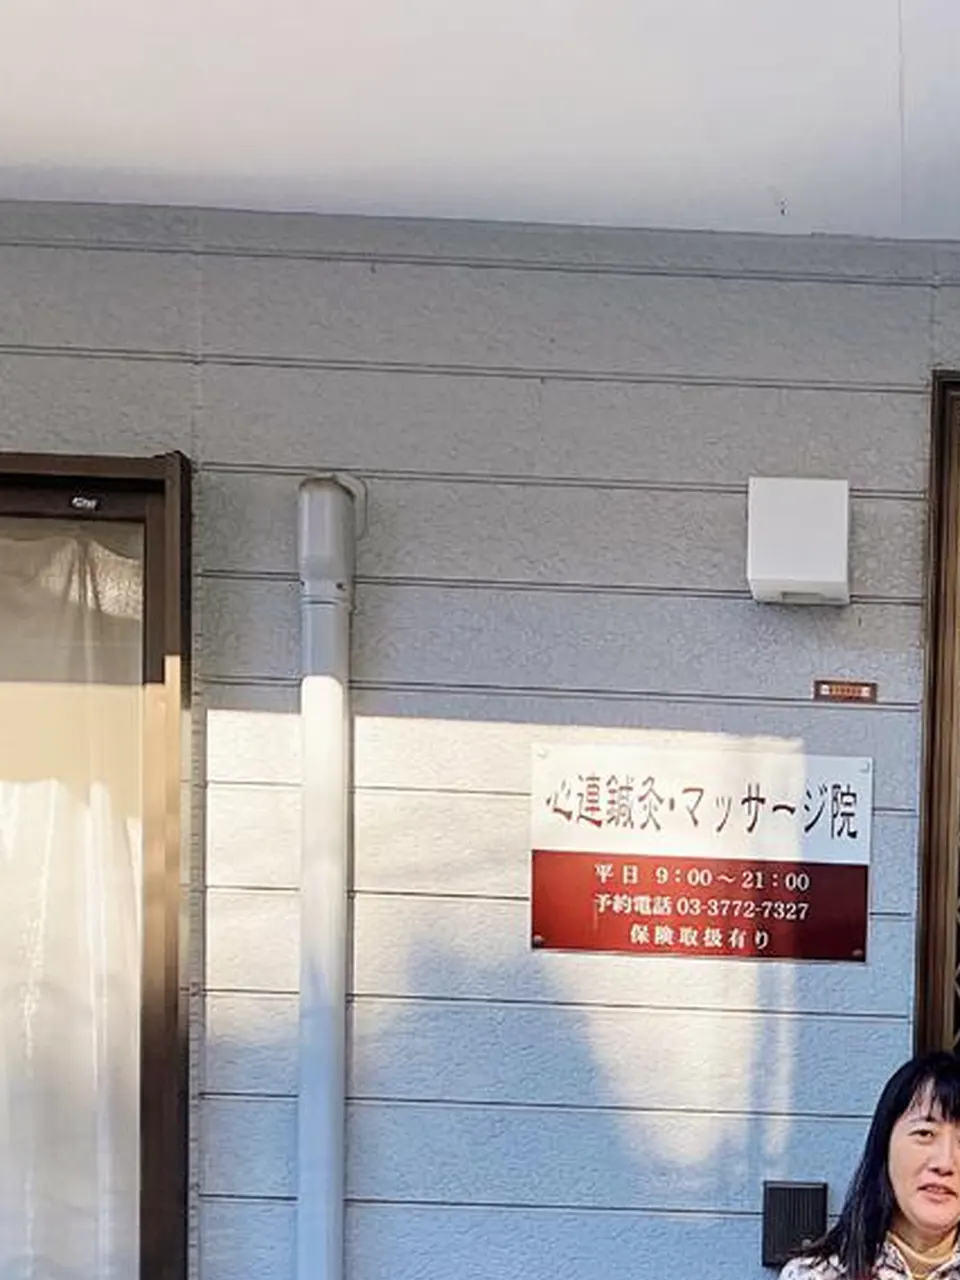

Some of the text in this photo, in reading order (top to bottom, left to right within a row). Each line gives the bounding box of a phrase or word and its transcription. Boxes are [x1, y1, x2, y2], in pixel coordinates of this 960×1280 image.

[594, 893, 810, 920] 予約電話 03-3772-7327
[629, 926, 770, 949] 保険取扱有り
